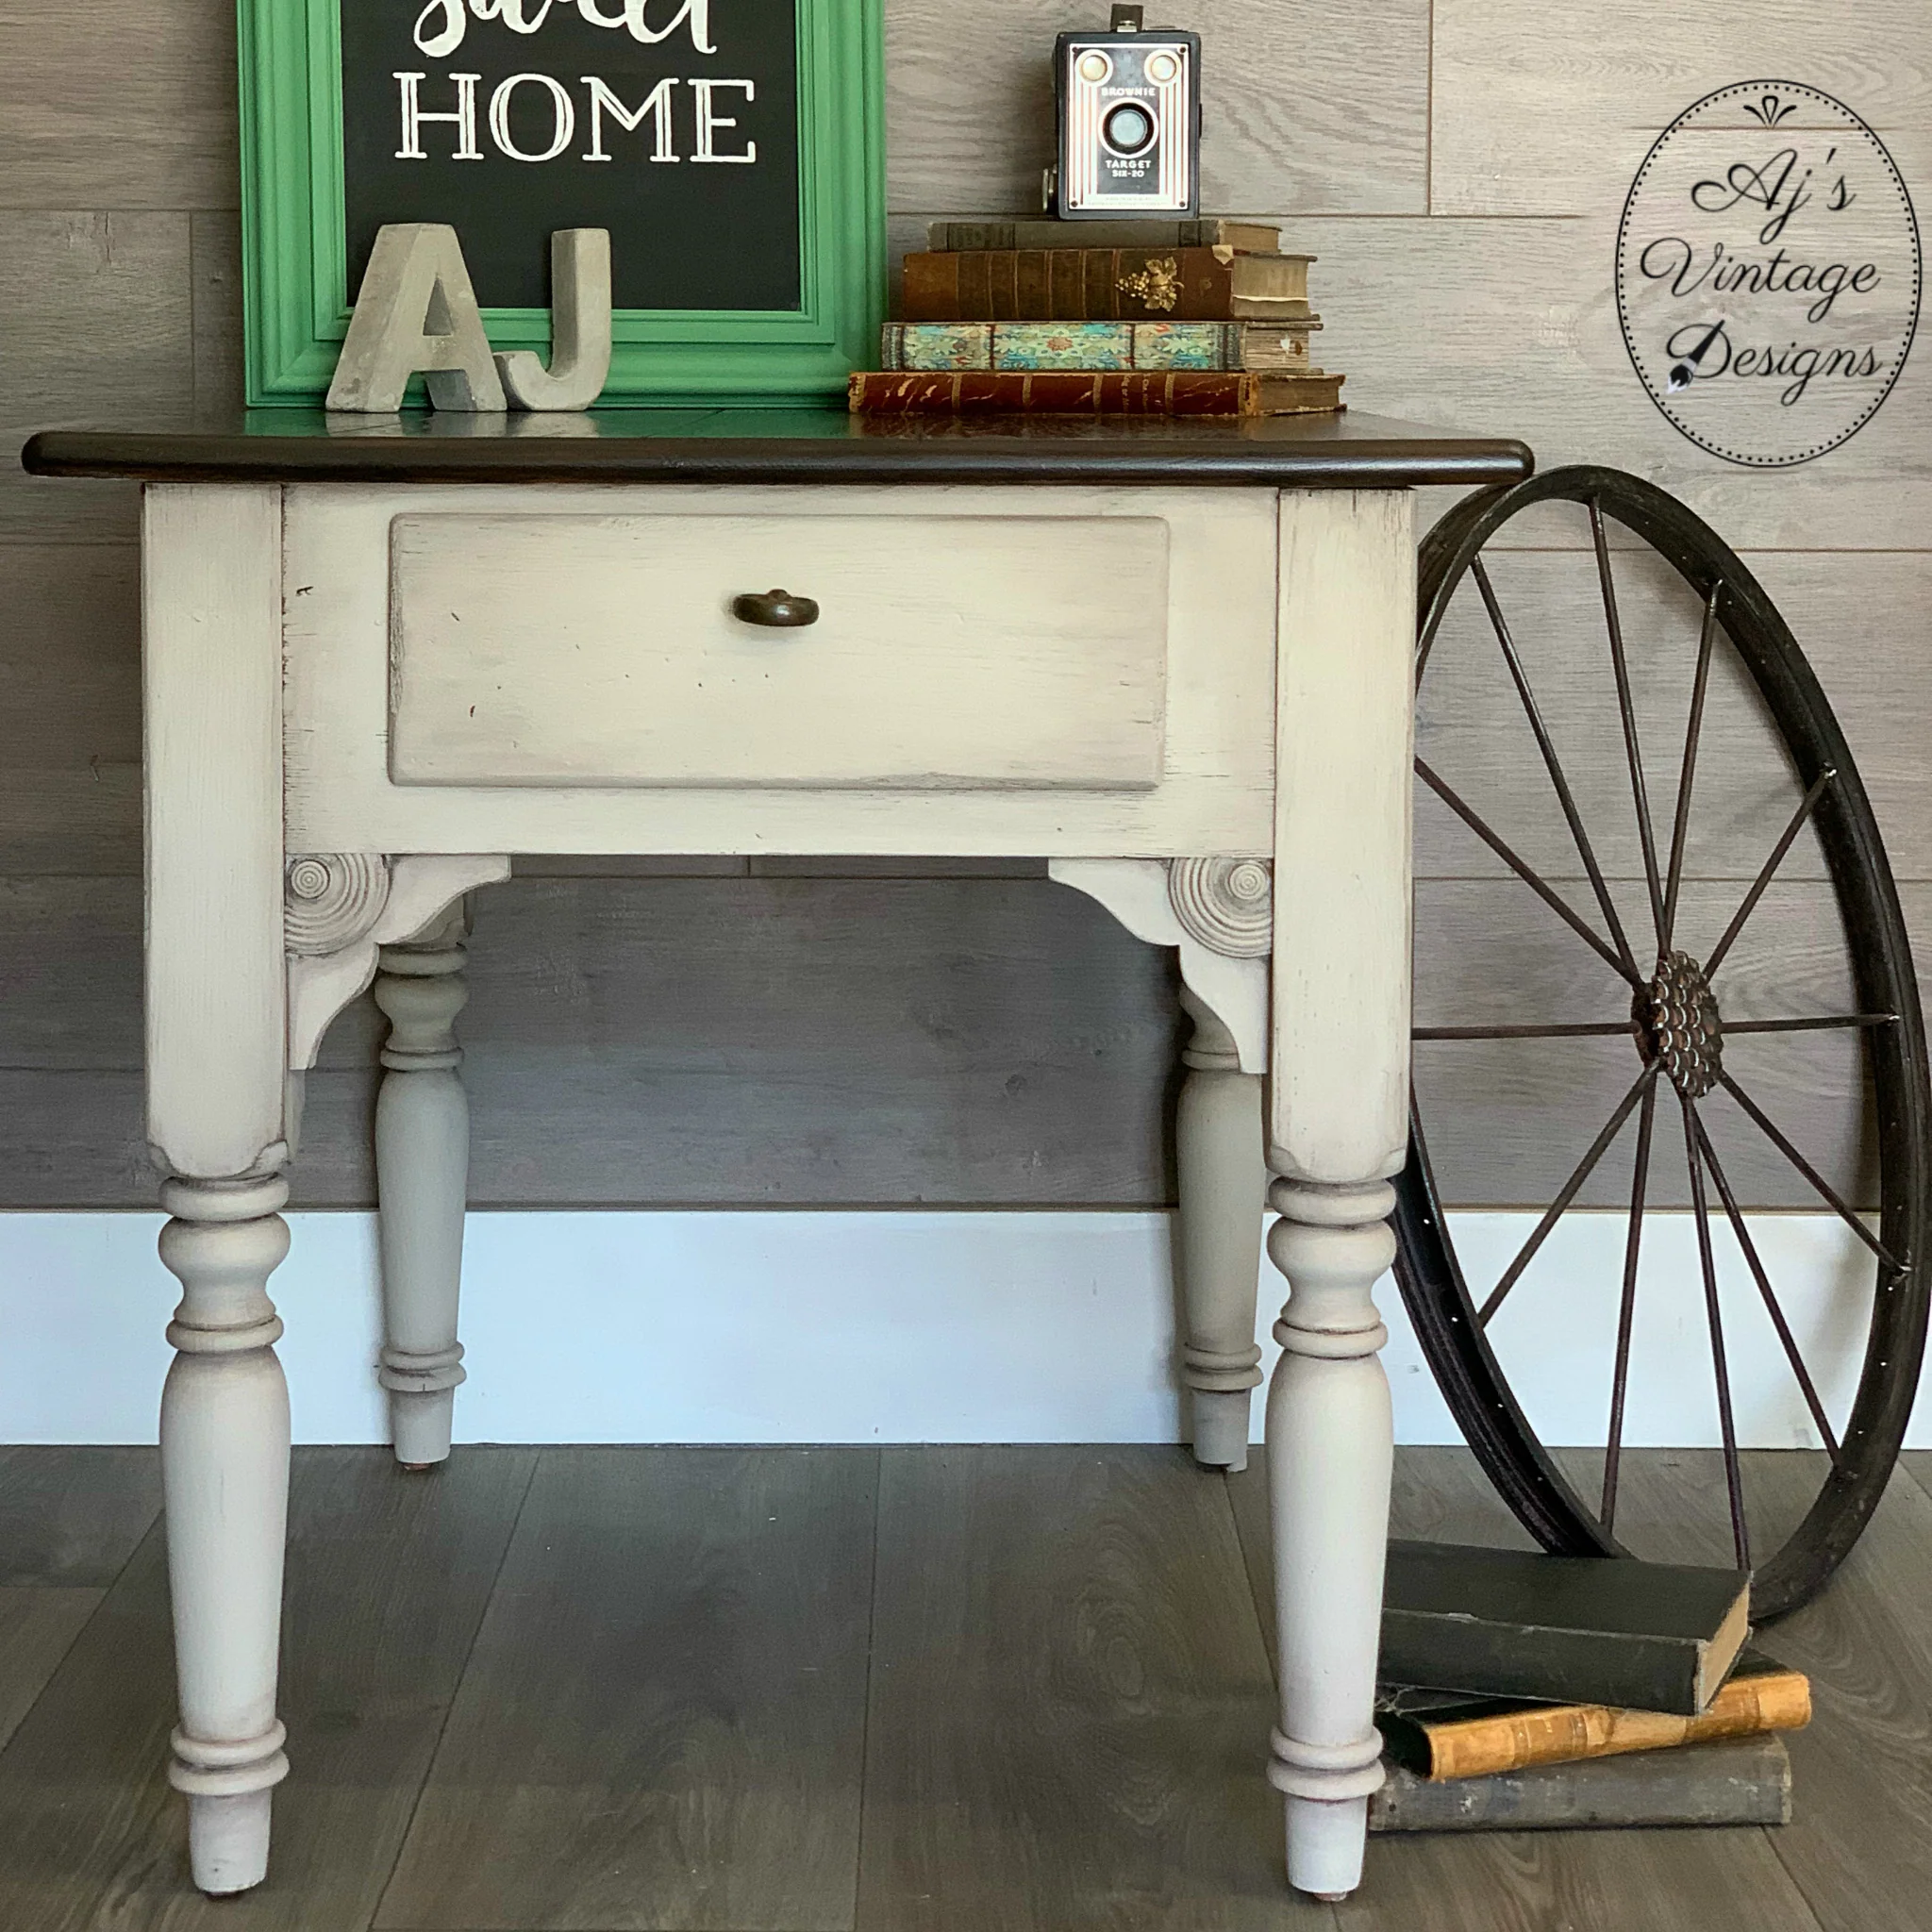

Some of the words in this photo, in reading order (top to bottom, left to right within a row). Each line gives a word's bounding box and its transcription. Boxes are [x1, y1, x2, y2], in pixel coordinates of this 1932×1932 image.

[1101, 87, 1156, 96] BROWNIE
[392, 72, 757, 163] HOME
[1105, 159, 1152, 169] TARGET
[1111, 169, 1145, 177] SIX-20
